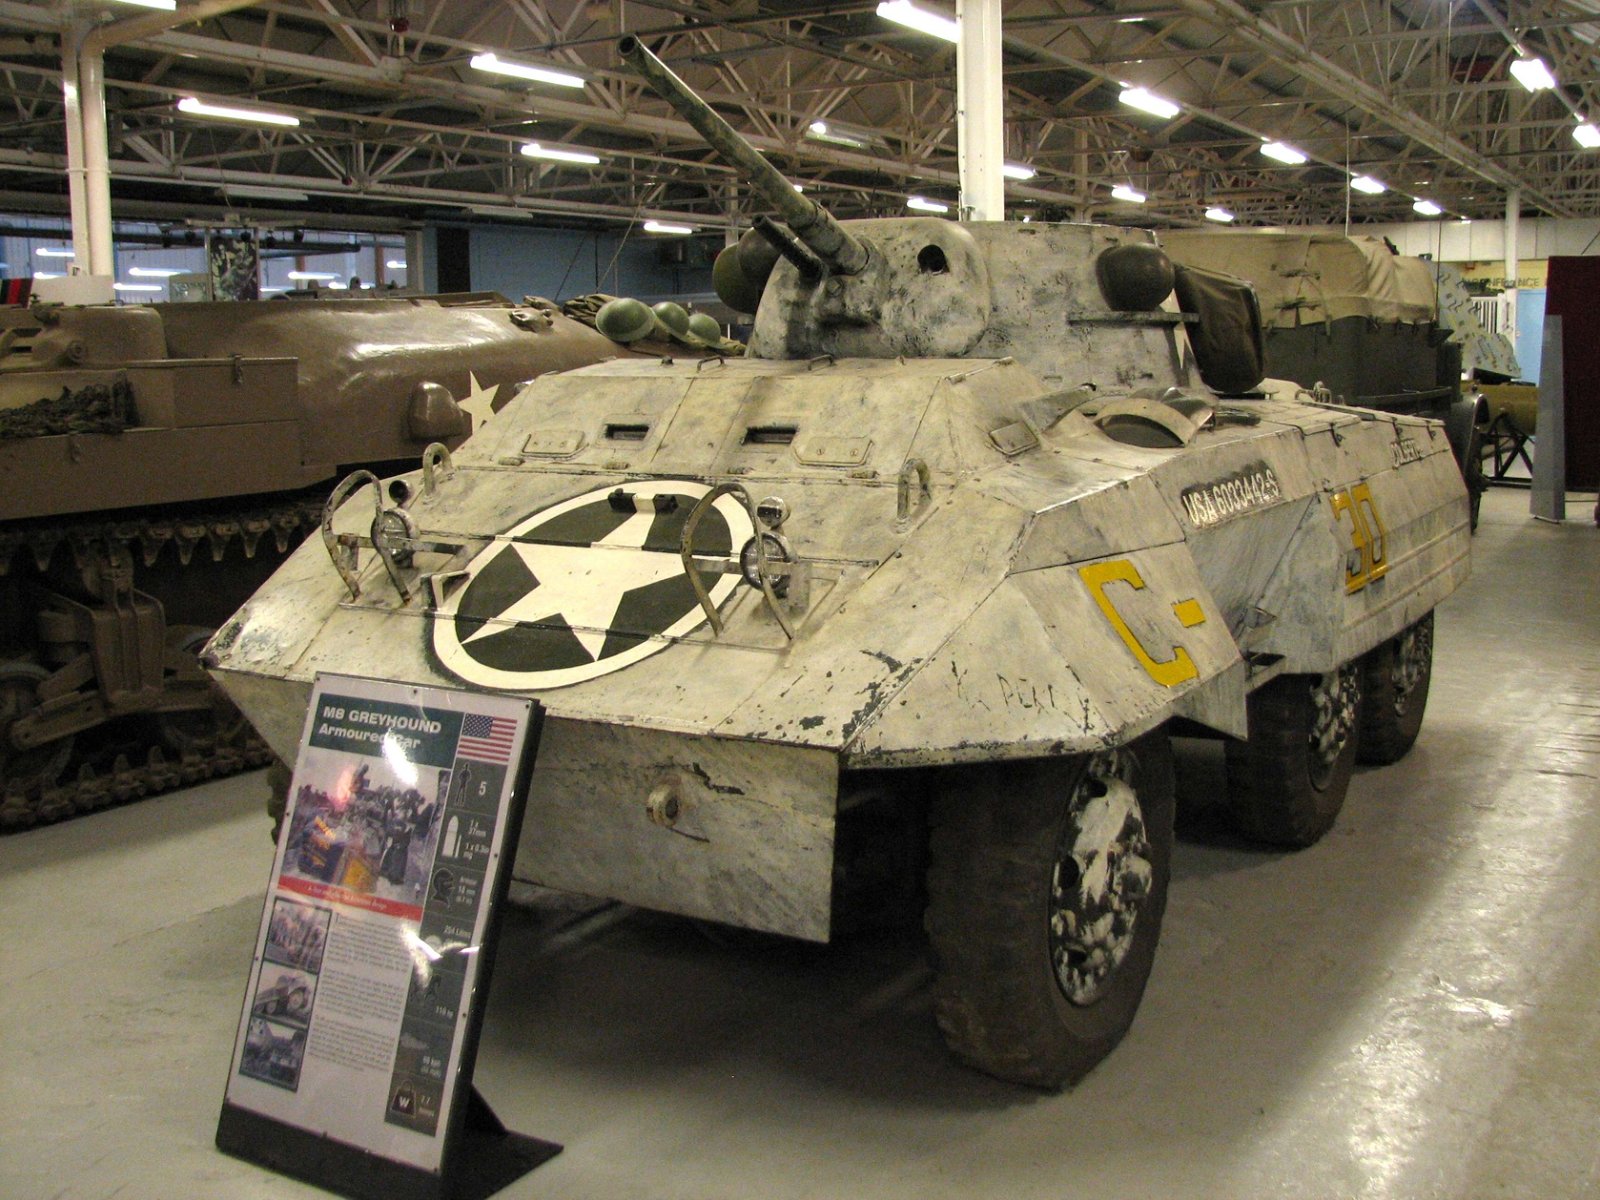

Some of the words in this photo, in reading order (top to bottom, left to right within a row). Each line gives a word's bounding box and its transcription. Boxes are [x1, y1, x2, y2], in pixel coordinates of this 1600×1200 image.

[1183, 490, 1218, 526] USA
[323, 706, 345, 720] M8
[348, 710, 442, 734] GREYHOUND
[478, 781, 488, 796] 5
